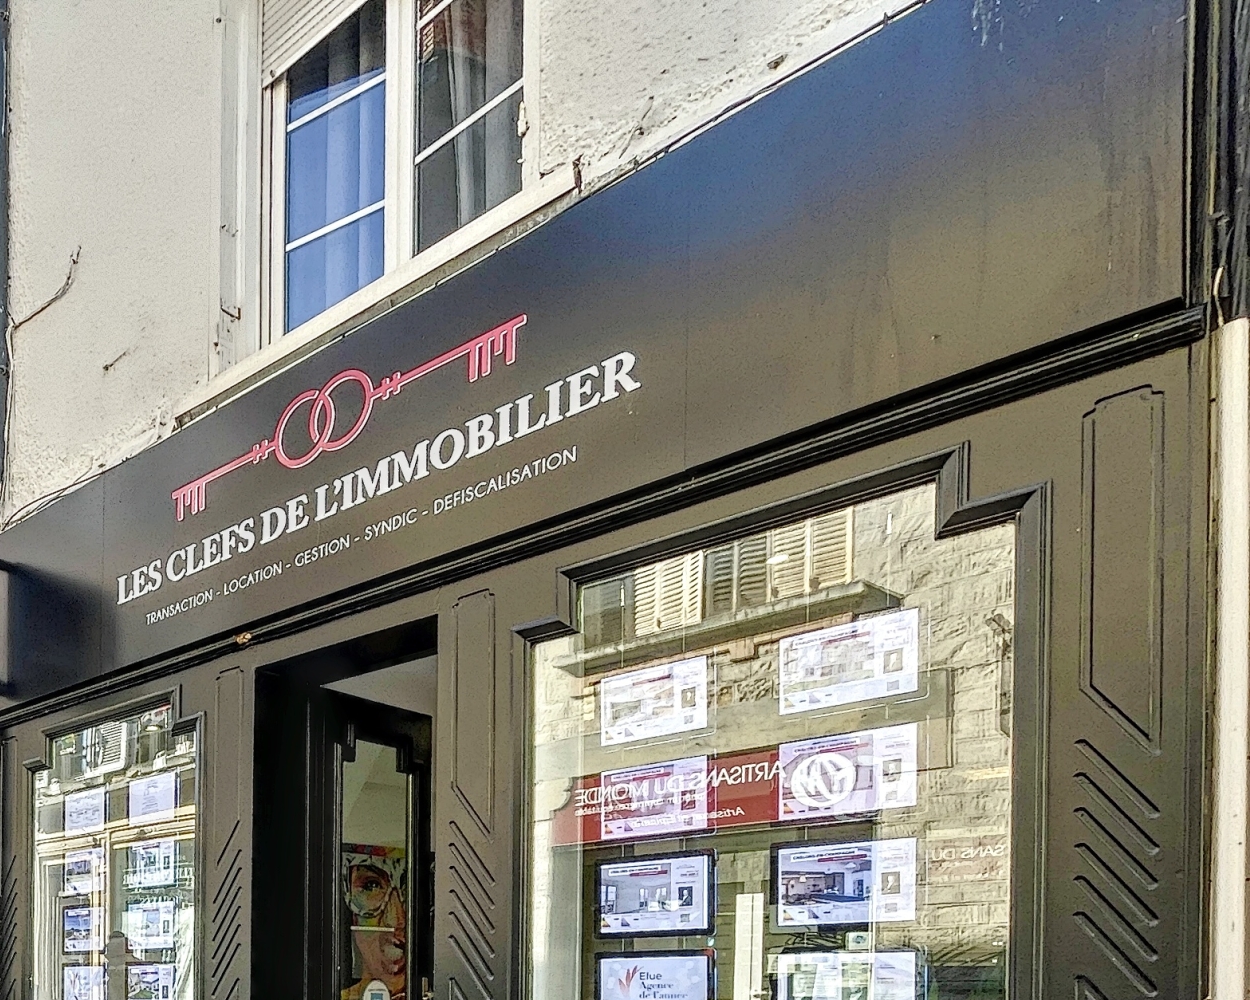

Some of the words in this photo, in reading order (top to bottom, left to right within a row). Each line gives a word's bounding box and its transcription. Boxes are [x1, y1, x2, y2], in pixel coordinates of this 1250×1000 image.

[116, 557, 162, 605] LES
[165, 510, 255, 583] CLEFS
[259, 493, 311, 545] DE
[314, 350, 643, 520] L'IMMOBILIER
[145, 589, 214, 626] TRANSACTION
[223, 563, 284, 598] LOCATION
[294, 533, 352, 568] GESTION
[364, 507, 419, 542] SYNDIC
[433, 446, 579, 516] DEFISCALISATION
[639, 972, 663, 981] Elue
[640, 982, 674, 991] Agence
[639, 991, 651, 999] de
